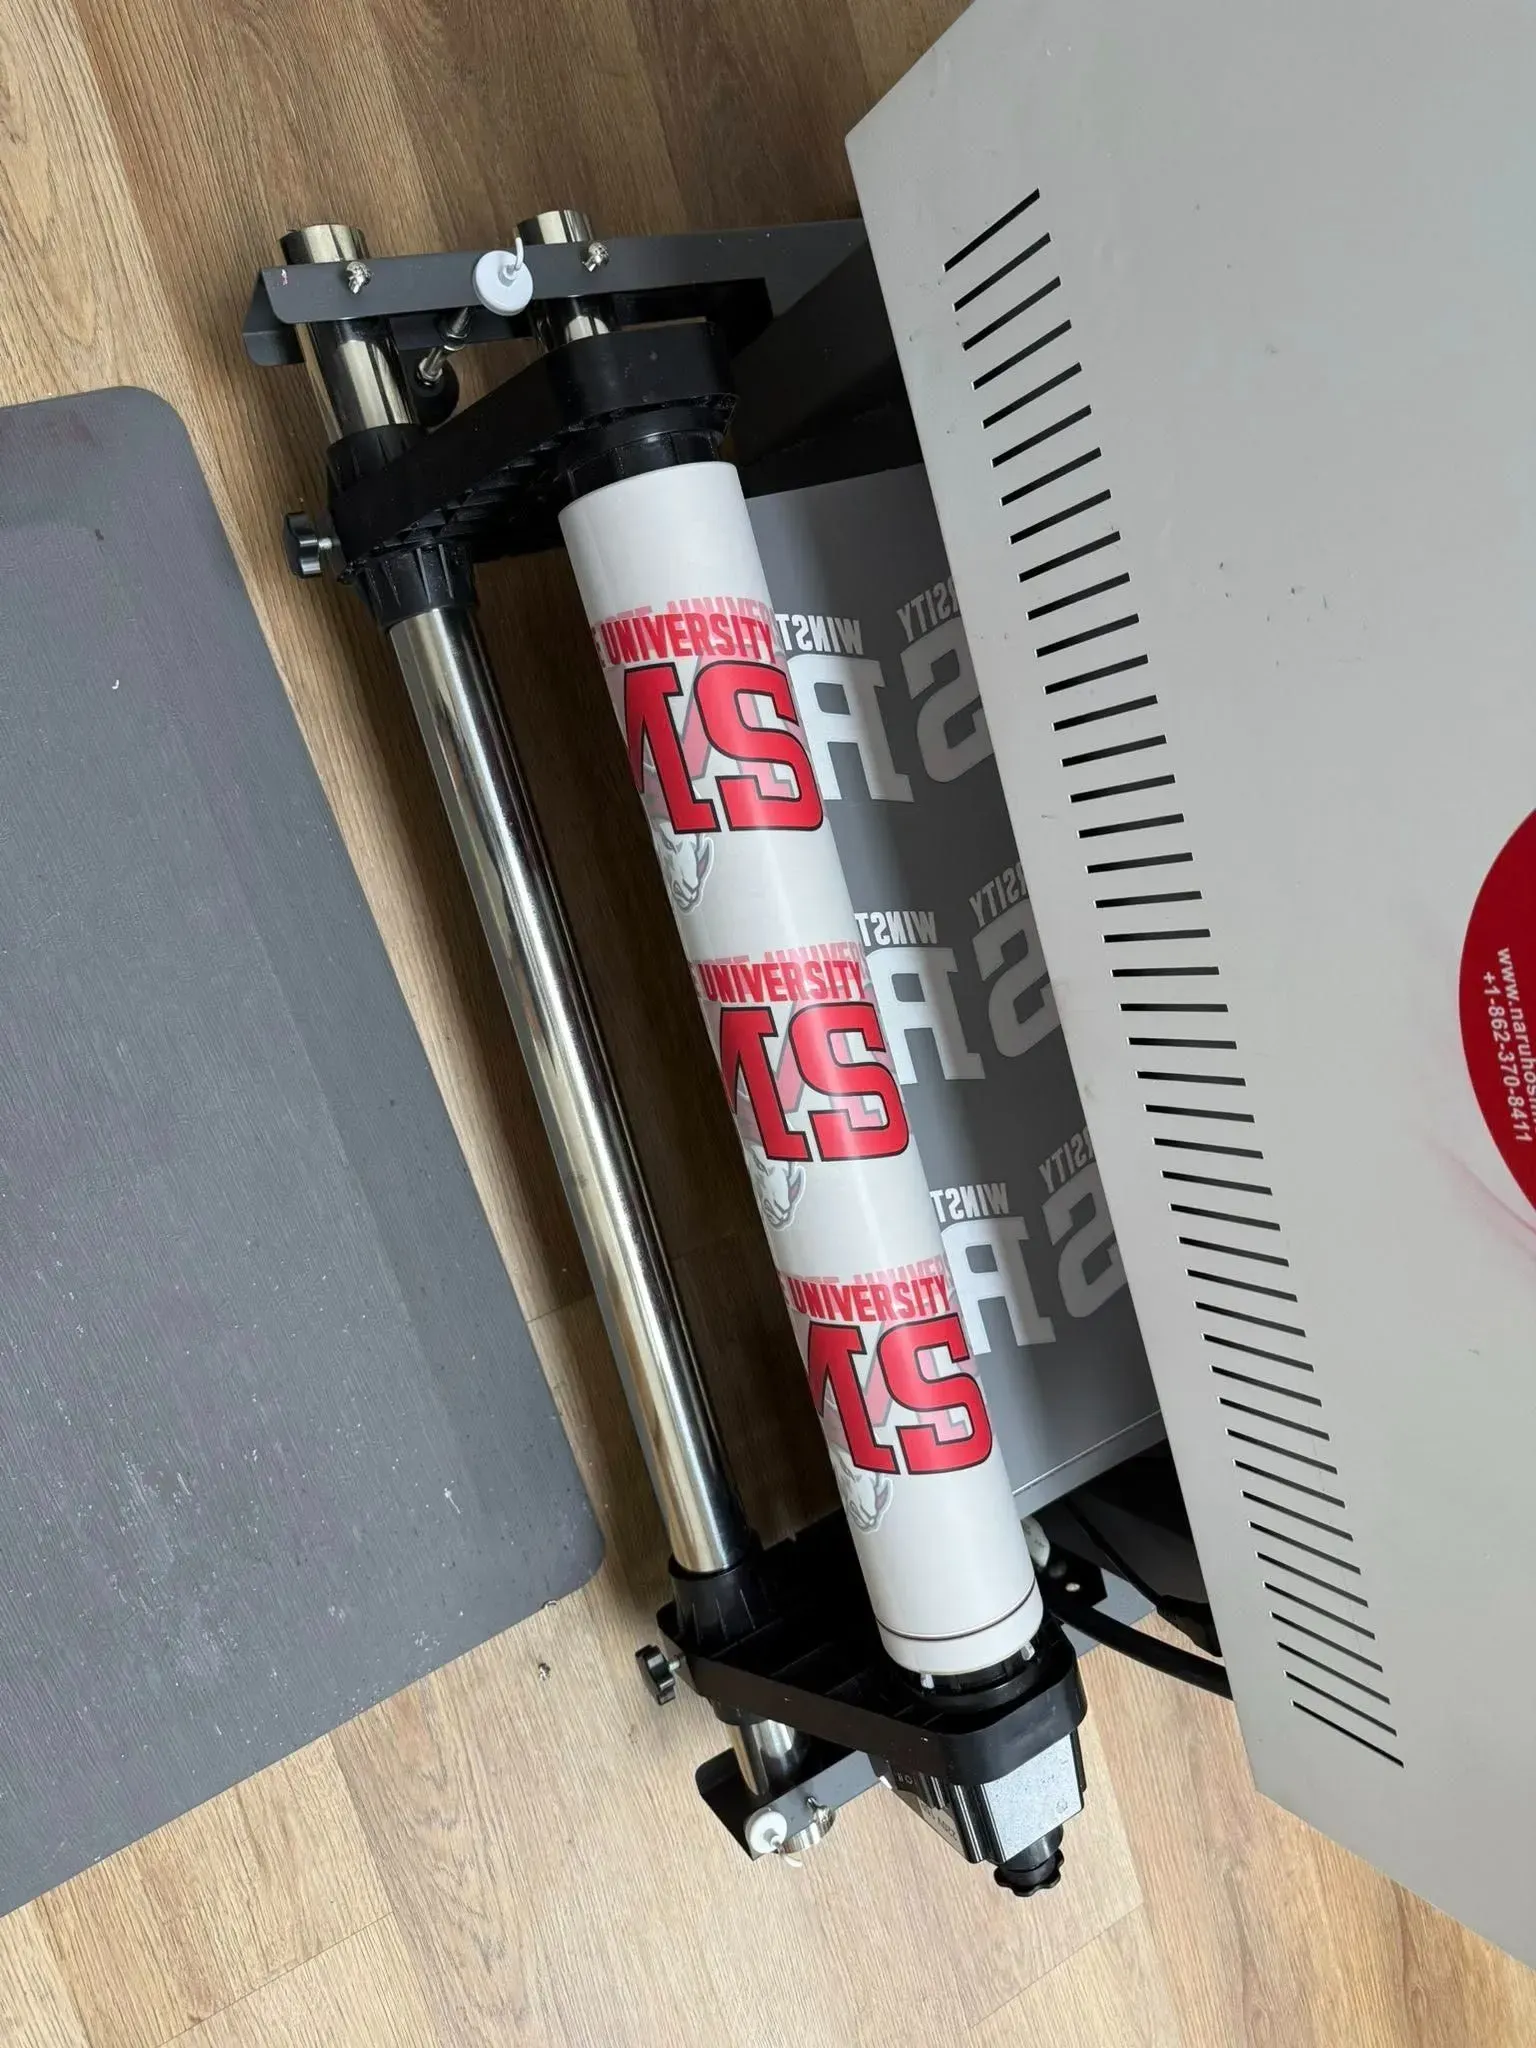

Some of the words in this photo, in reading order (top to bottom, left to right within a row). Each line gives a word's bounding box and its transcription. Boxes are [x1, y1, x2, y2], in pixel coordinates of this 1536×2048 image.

[601, 613, 776, 665] UNIVERSITY
[698, 960, 866, 1003] UNIVERSITY
[1483, 971, 1532, 1142] +1-862-370-8411
[787, 1275, 950, 1322] UNIVERSITY
